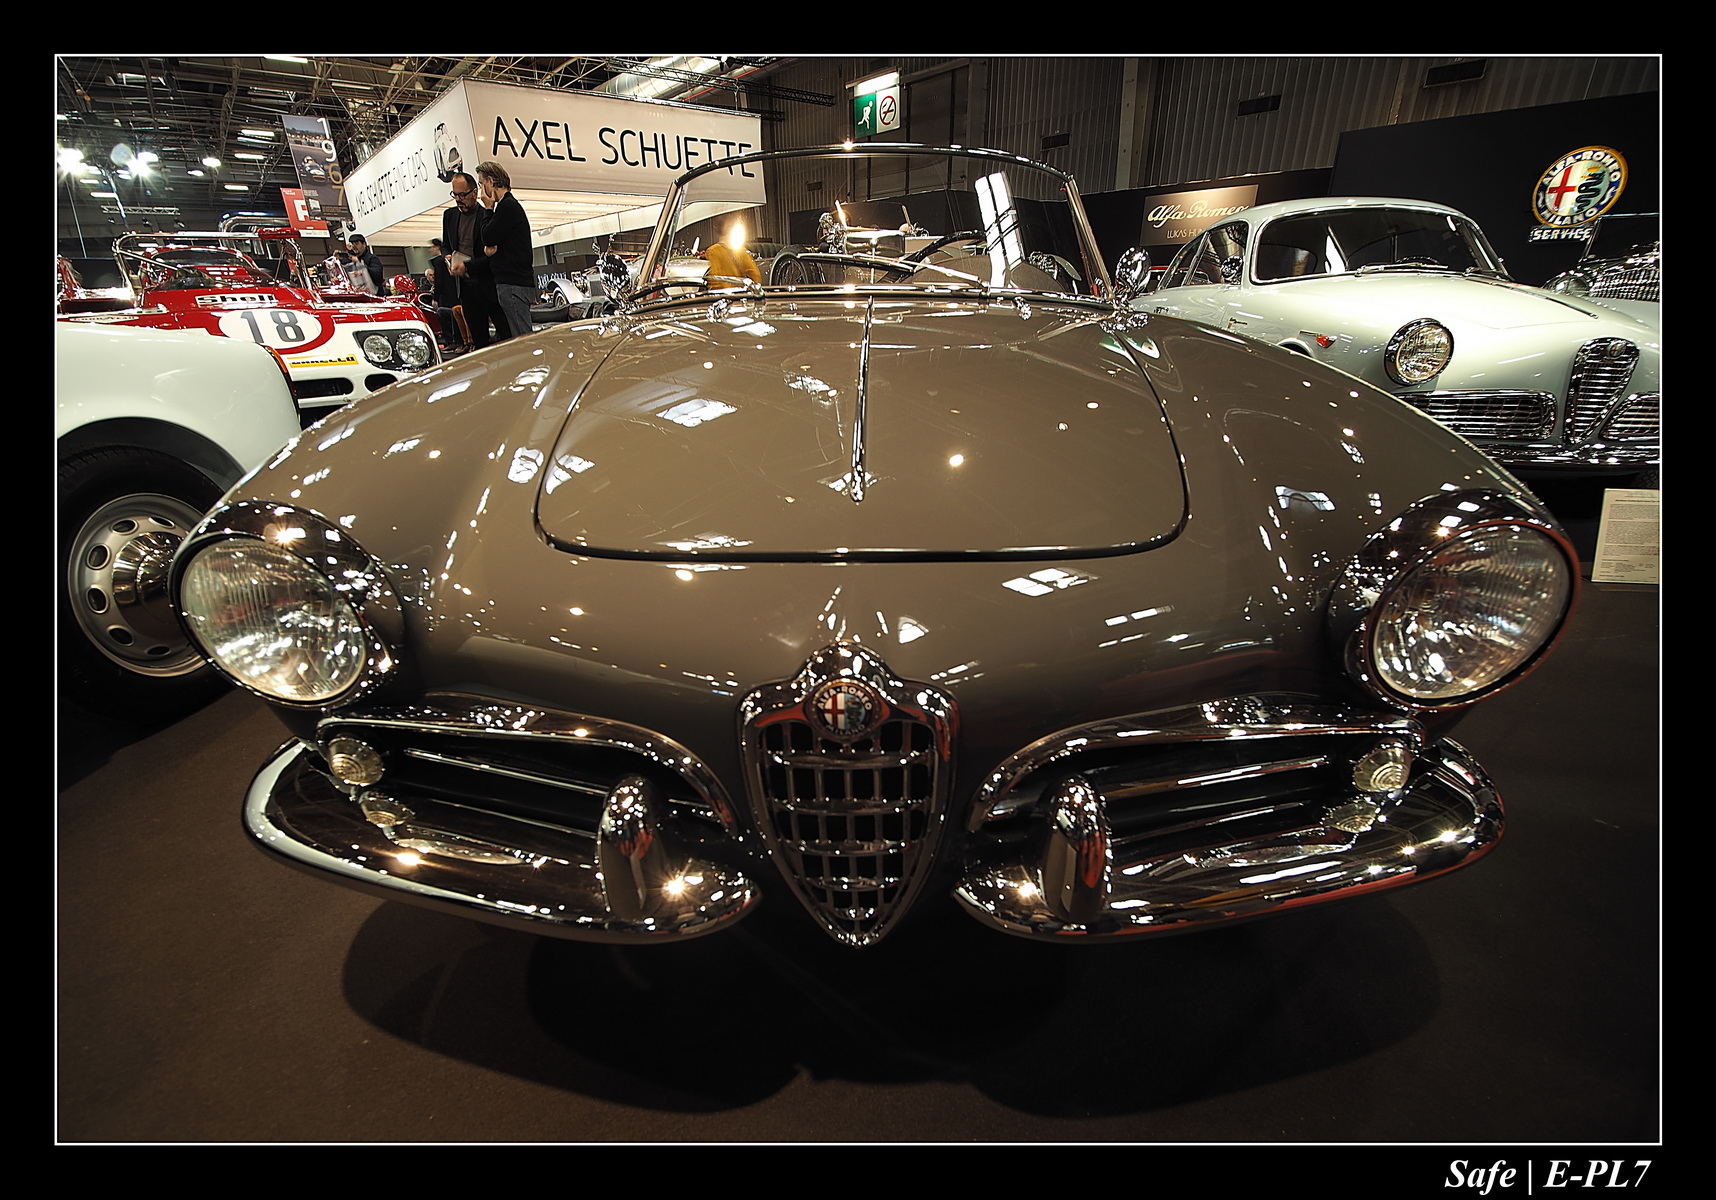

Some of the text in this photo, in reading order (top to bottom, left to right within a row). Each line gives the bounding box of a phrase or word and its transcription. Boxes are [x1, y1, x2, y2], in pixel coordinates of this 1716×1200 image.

[492, 115, 755, 178] AXEL SCHUETTE
[406, 148, 429, 189] CARS
[1147, 200, 1249, 229] Alfa Romeo
[1540, 207, 1598, 226] MILANO
[1532, 228, 1594, 241] SERVICE
[240, 310, 305, 344] 18
